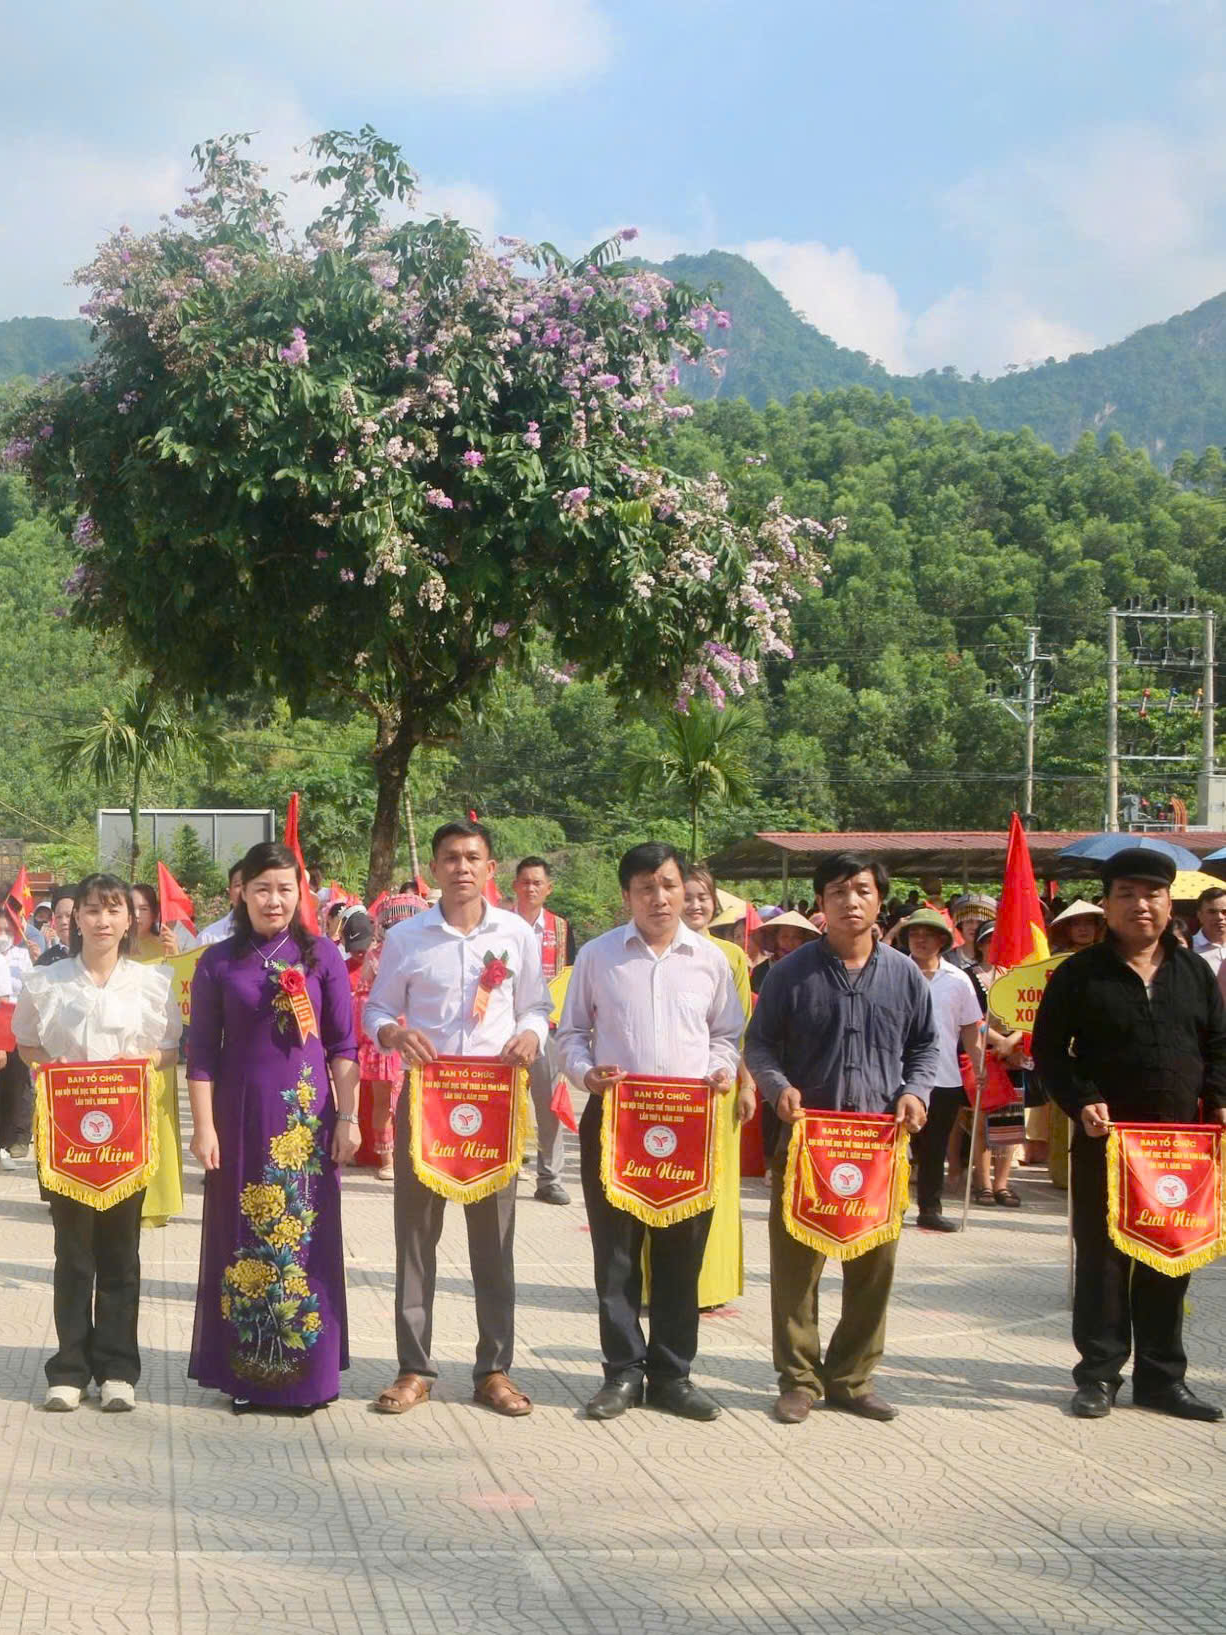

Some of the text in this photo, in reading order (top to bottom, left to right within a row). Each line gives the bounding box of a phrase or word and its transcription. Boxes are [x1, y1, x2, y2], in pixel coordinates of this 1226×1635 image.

[1016, 1006, 1034, 1022] XÓ
[96, 1146, 134, 1166] Niệm
[461, 1141, 499, 1162] Niệm
[656, 1161, 696, 1183] Niệm
